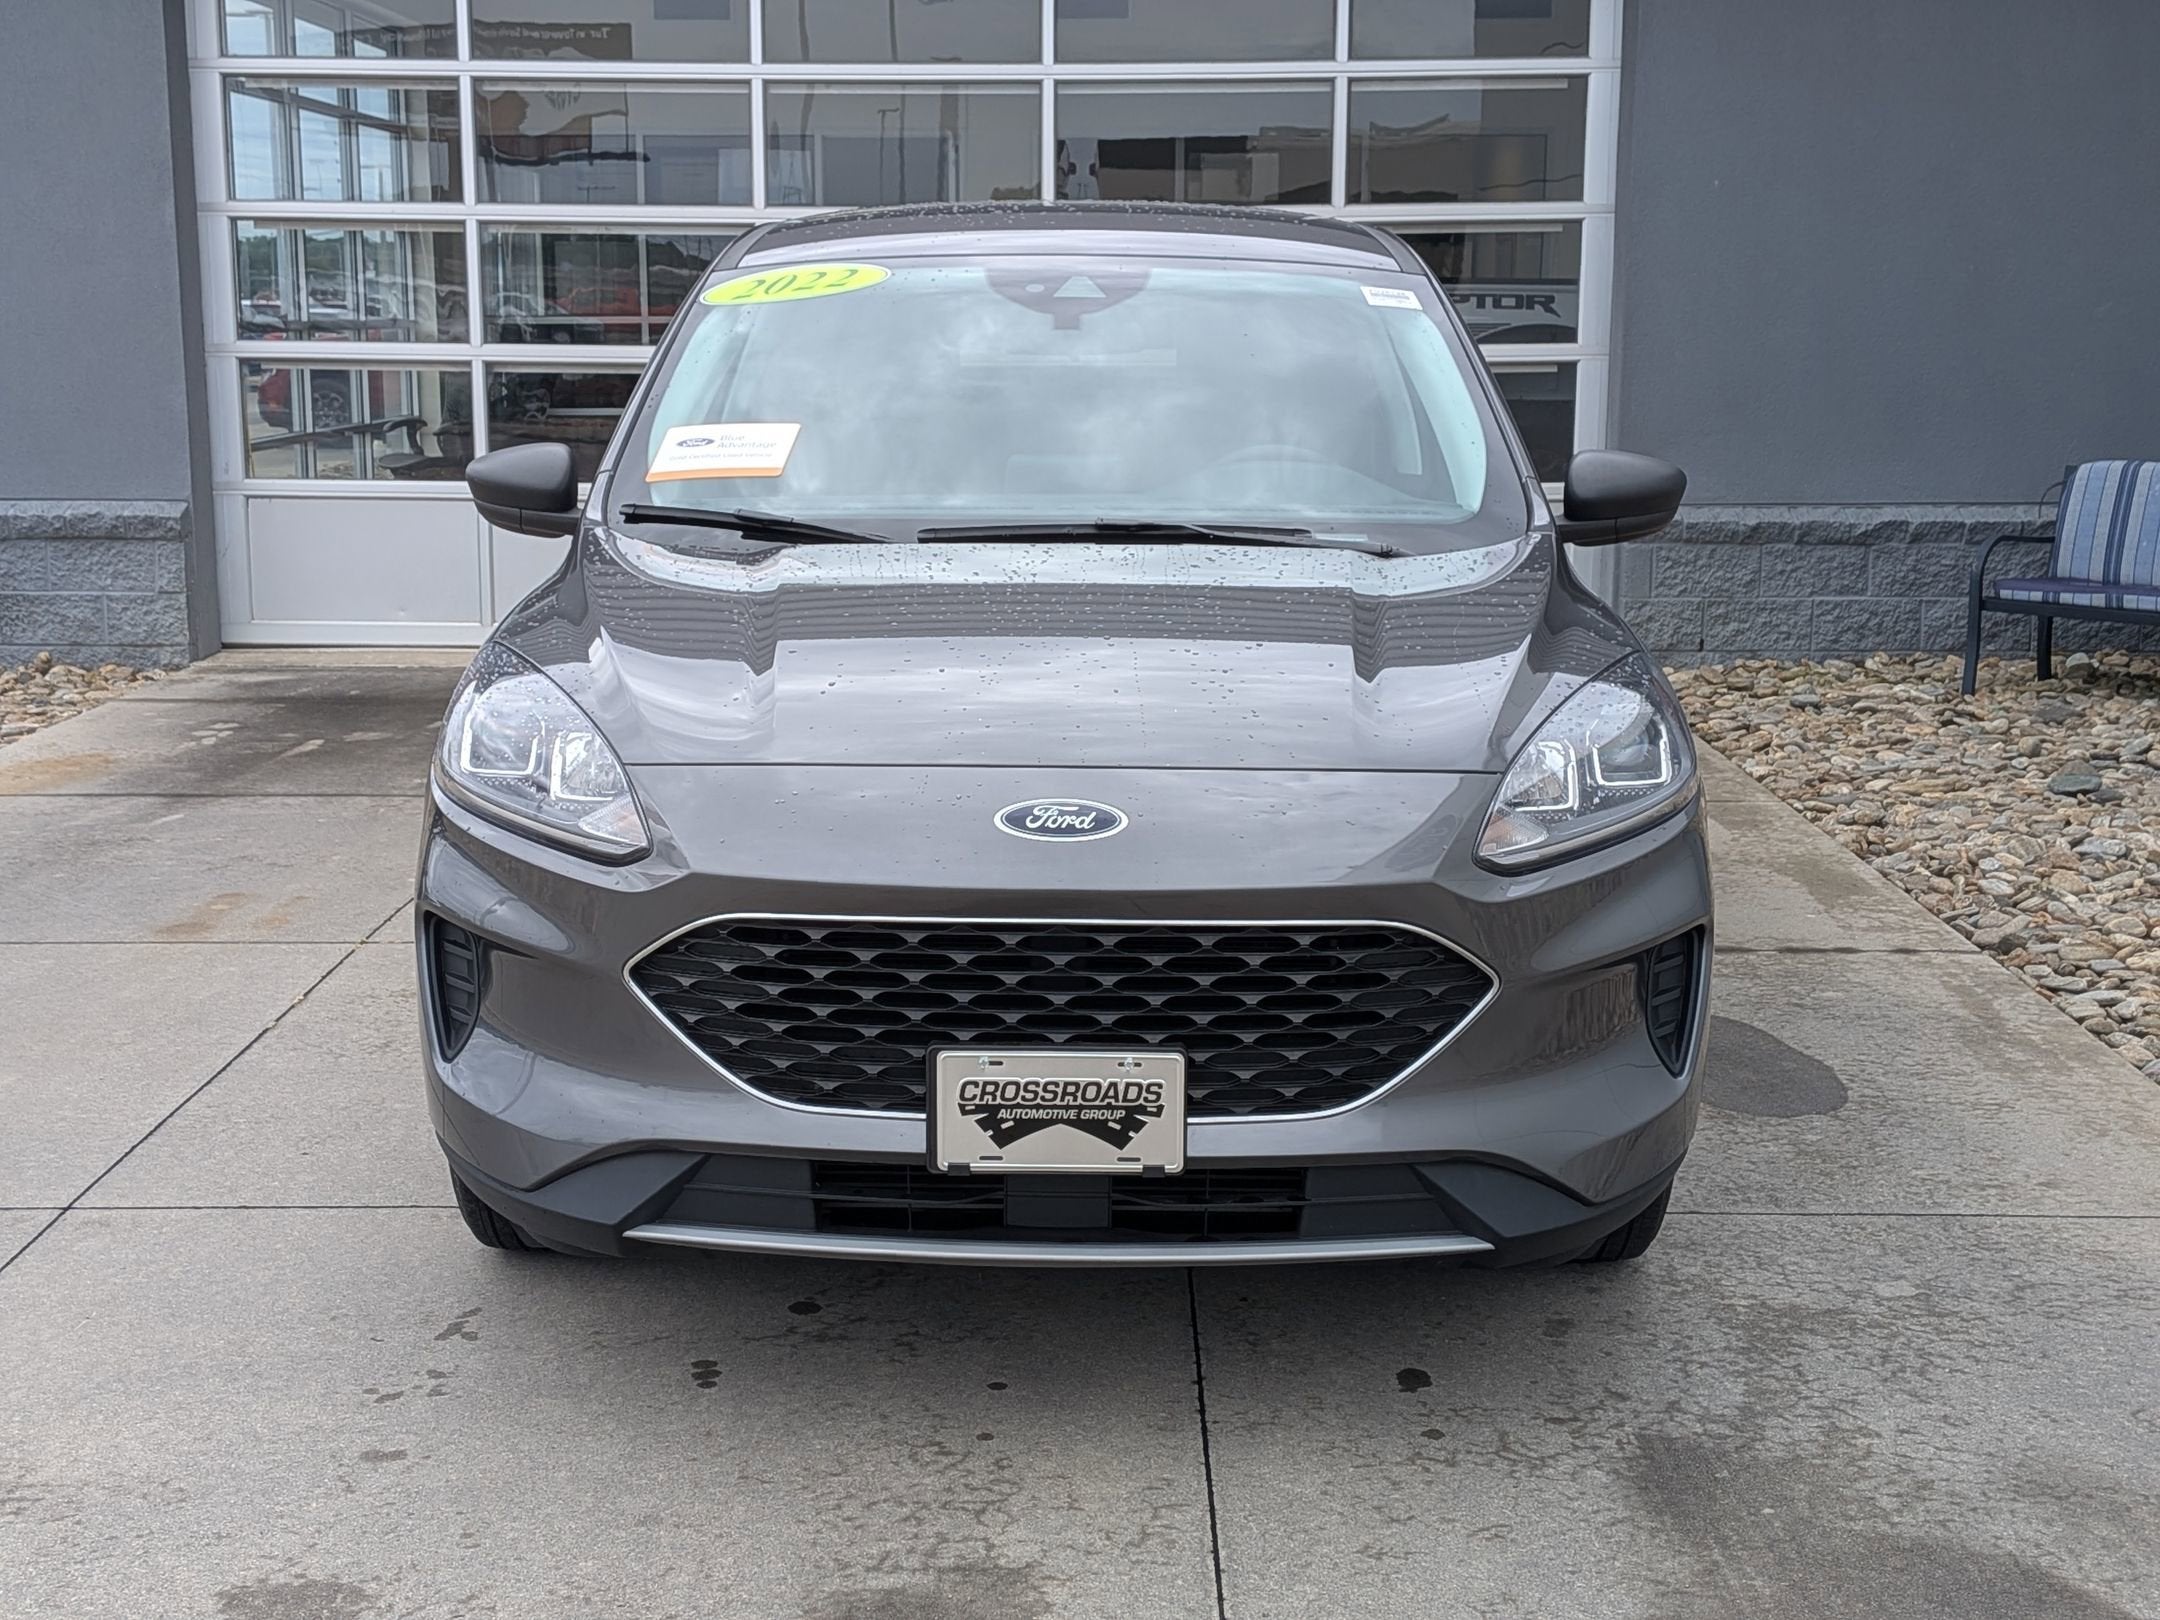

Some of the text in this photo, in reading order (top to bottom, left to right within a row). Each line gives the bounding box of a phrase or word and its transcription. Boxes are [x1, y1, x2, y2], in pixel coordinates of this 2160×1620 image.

[732, 269, 859, 300] 2022
[1026, 805, 1097, 829] Ford
[958, 1079, 1164, 1105] CROSSROADS
[997, 1108, 1126, 1121] AUTOMOTIVE GROUP
